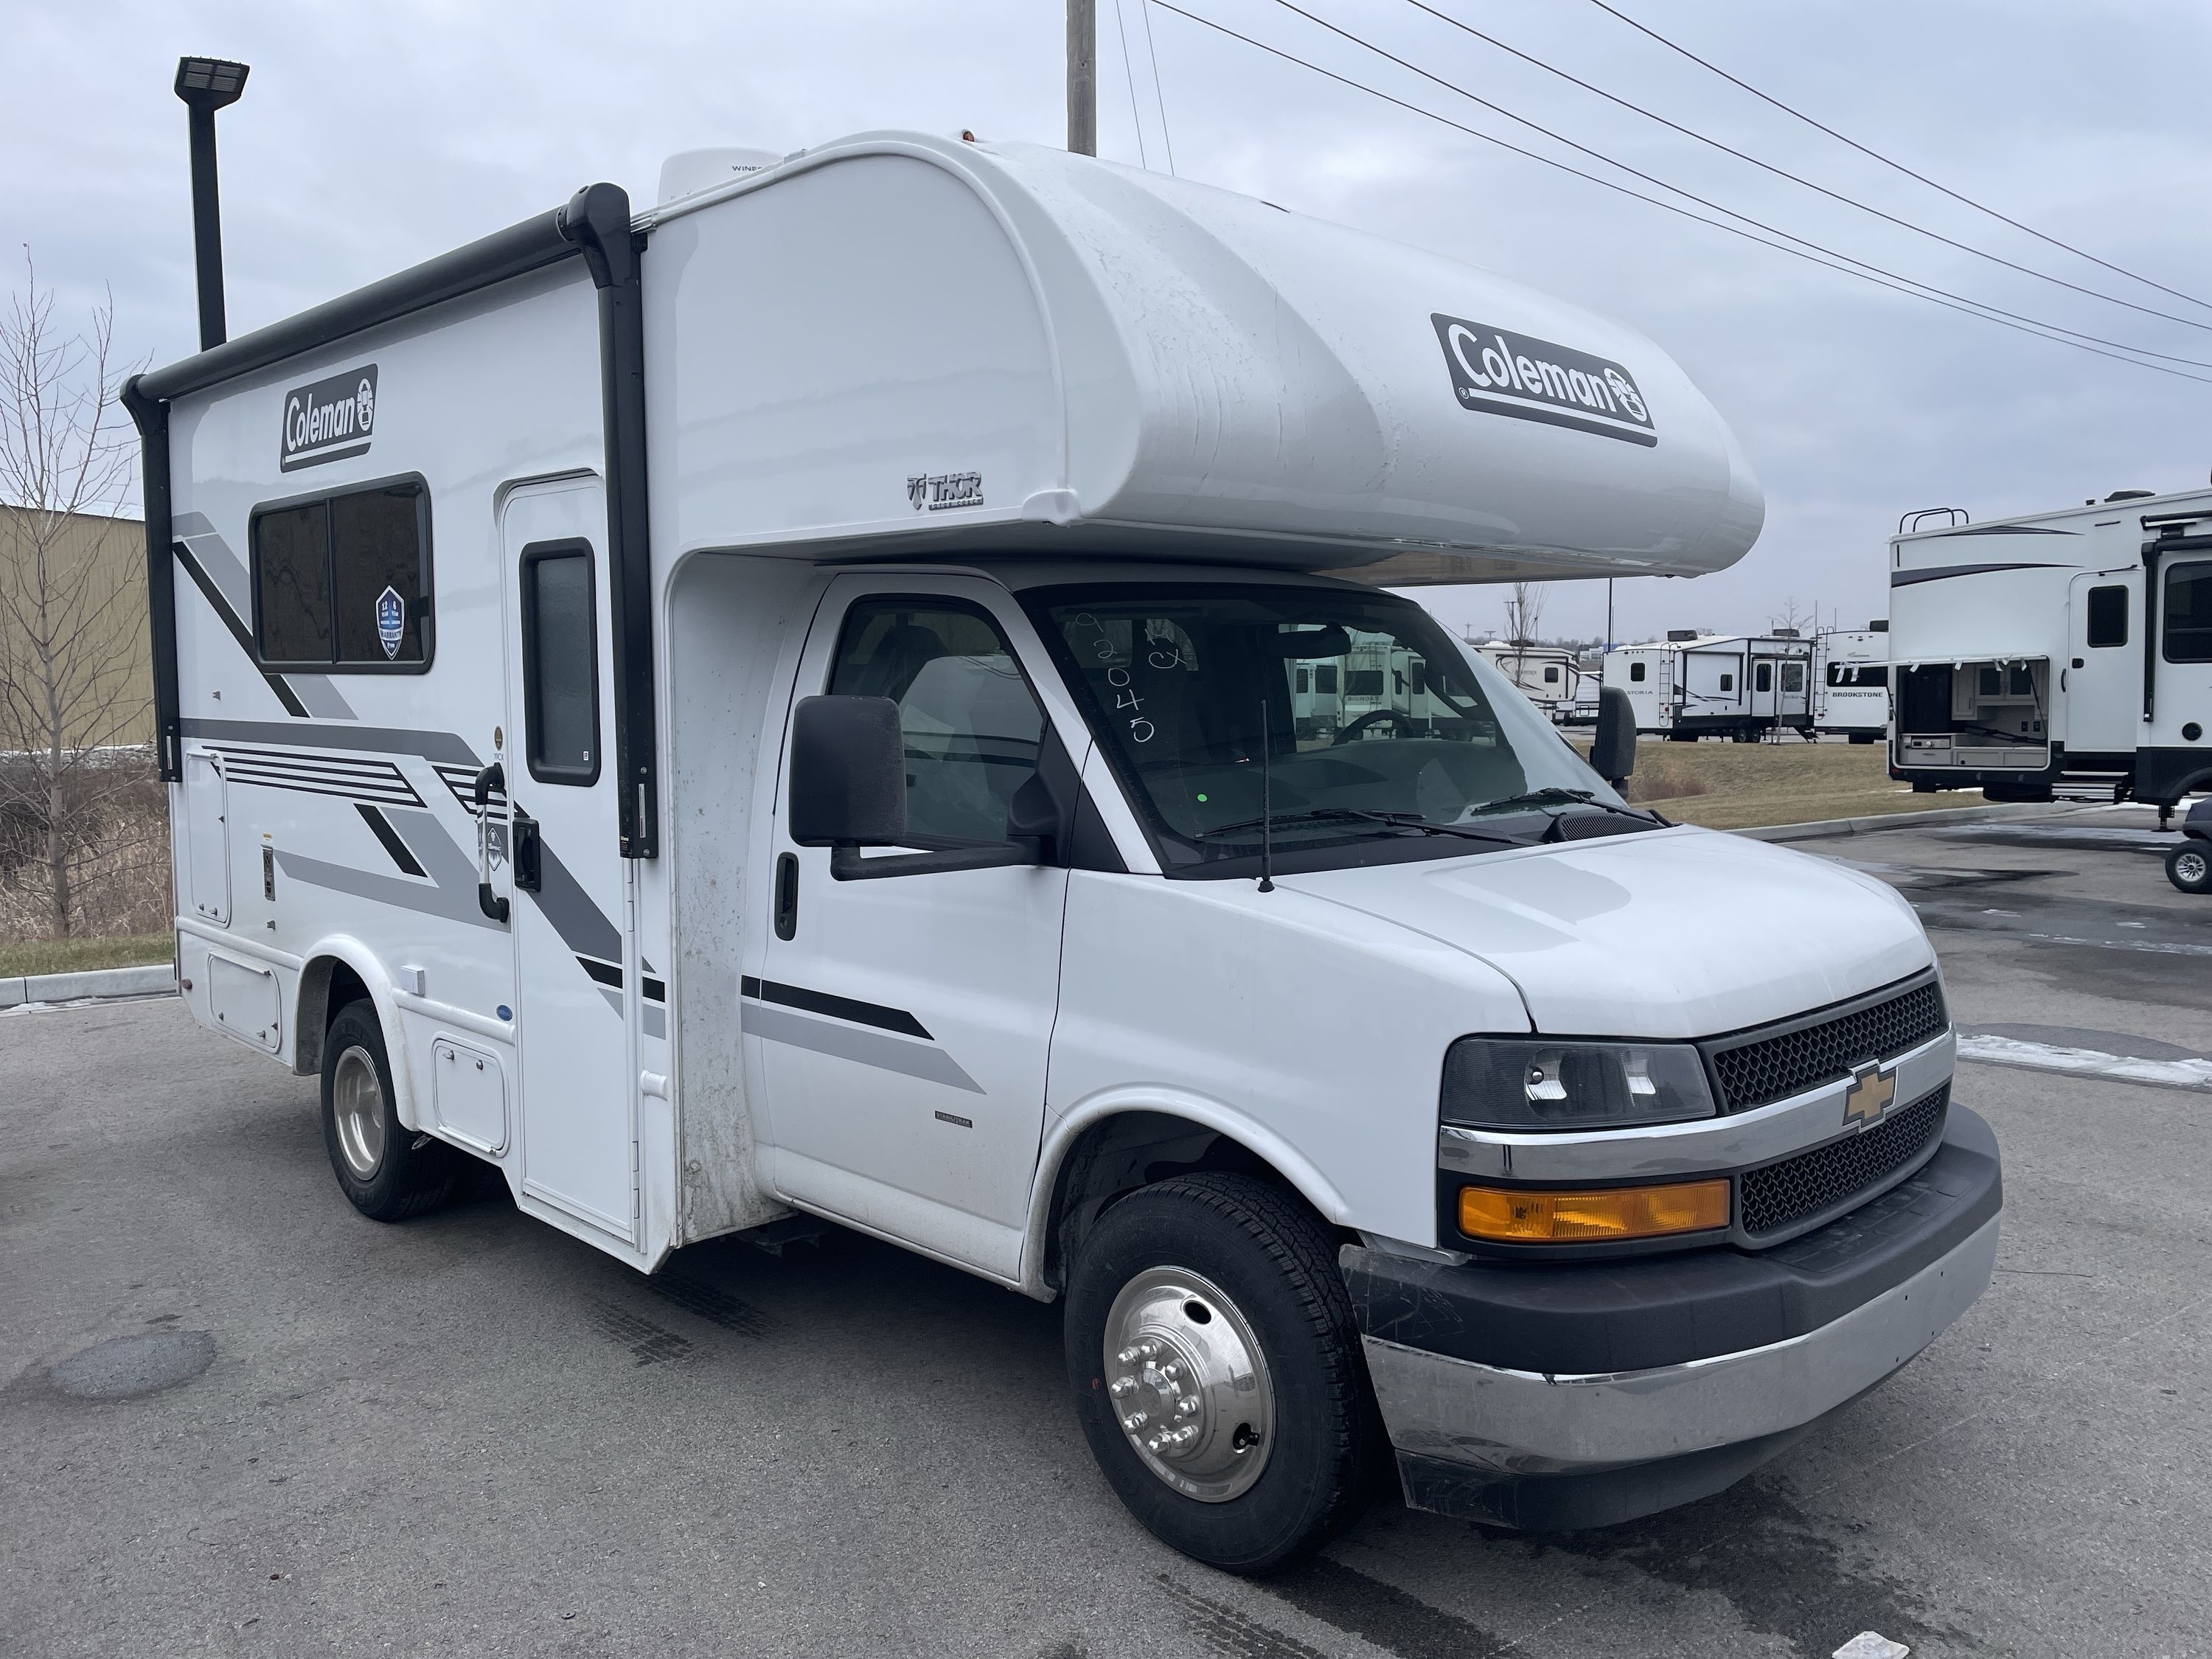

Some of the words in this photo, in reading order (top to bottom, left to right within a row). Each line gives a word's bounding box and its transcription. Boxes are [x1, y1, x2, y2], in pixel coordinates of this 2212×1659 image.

[1448, 323, 1617, 413] Coleman
[286, 393, 355, 452] Coleman
[928, 472, 984, 502] THOR
[958, 499, 983, 507] COACH
[382, 601, 388, 611] 12
[392, 600, 397, 611] 6
